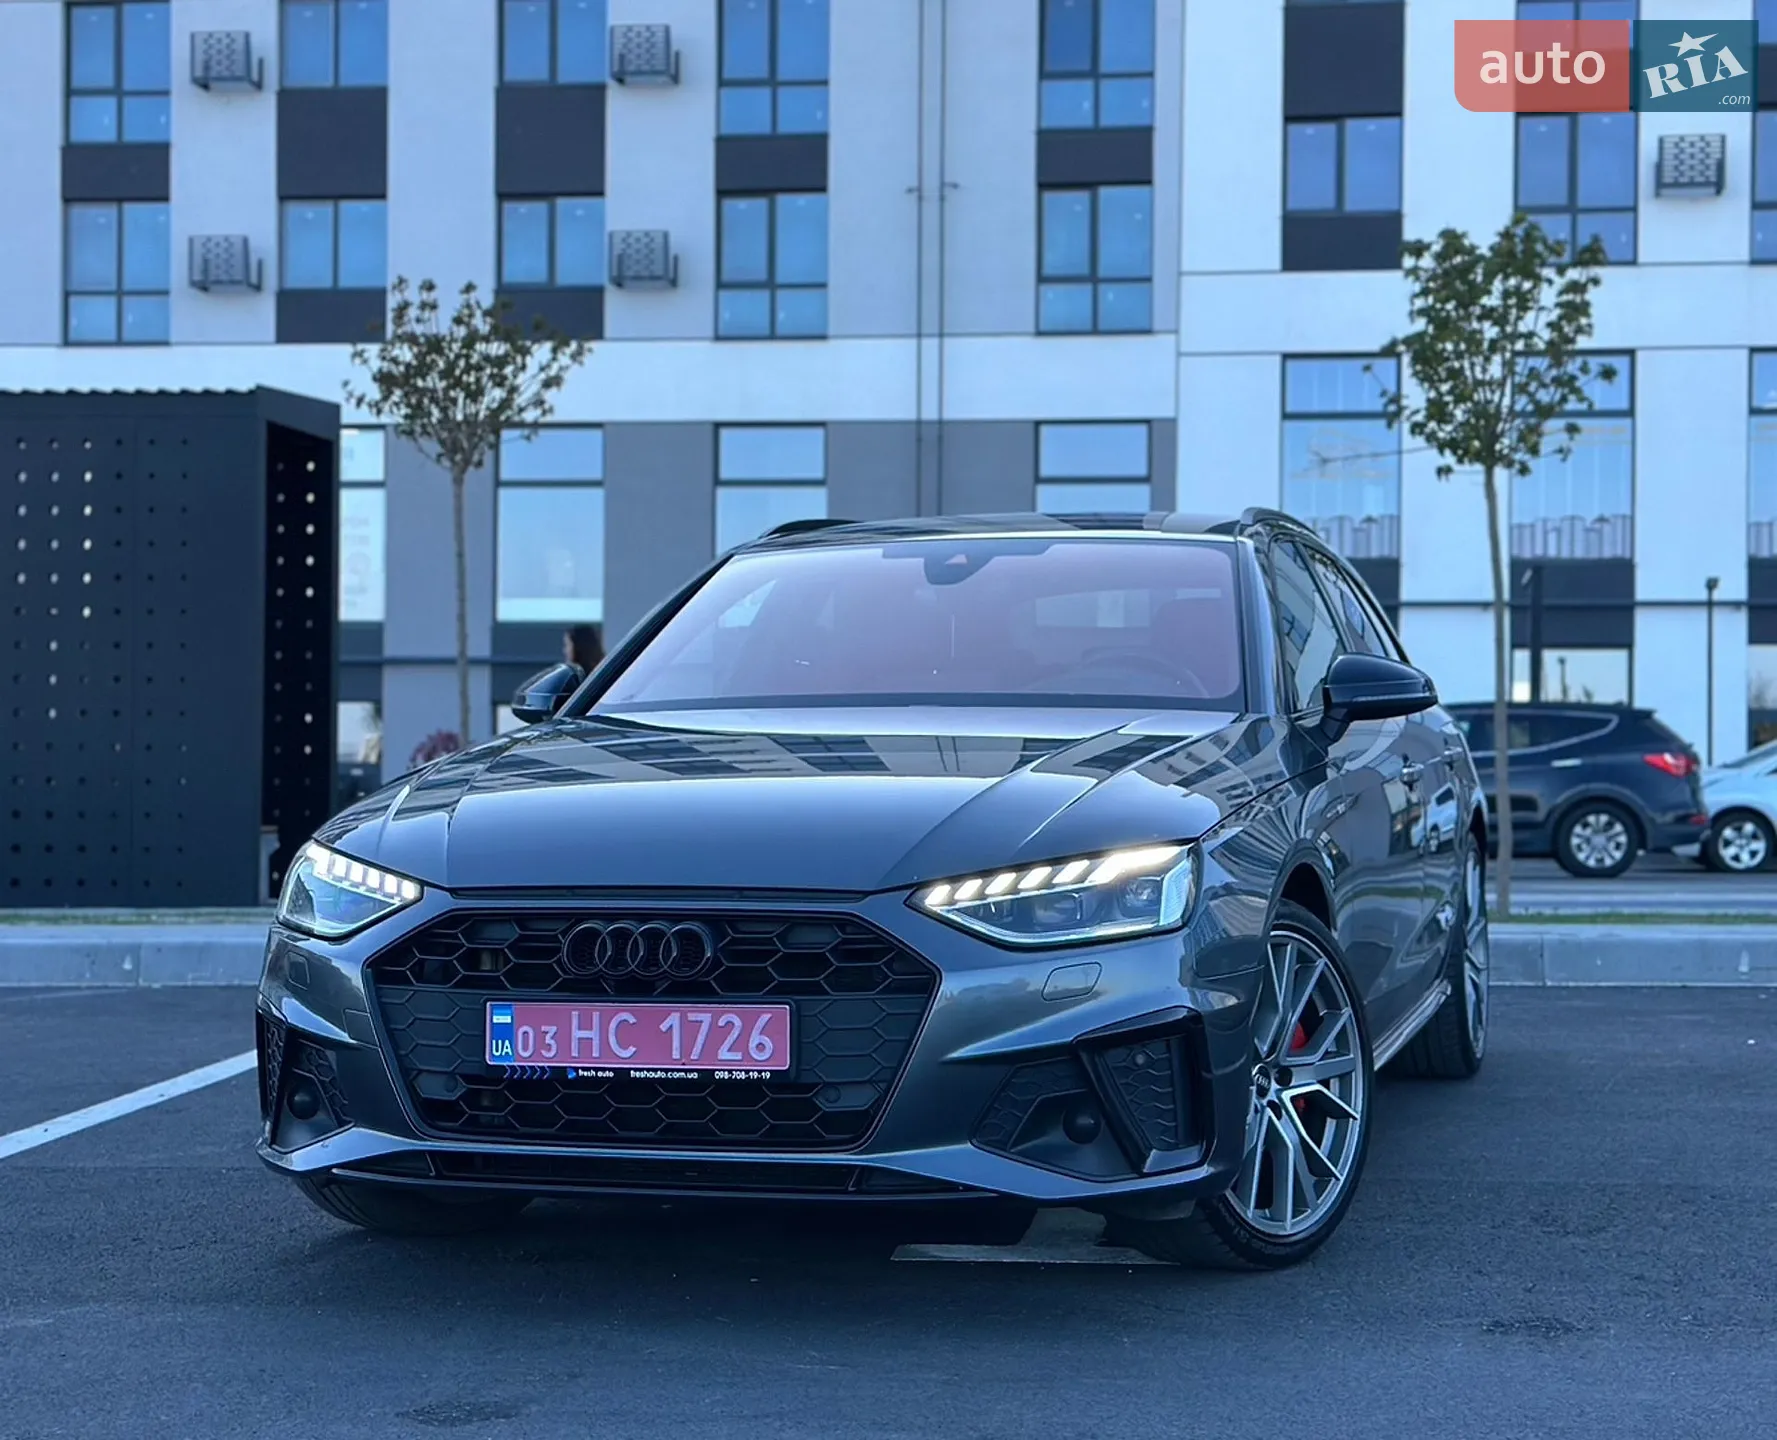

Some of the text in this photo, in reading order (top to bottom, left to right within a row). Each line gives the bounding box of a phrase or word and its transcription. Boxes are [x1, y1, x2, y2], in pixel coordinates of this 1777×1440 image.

[517, 1011, 773, 1061] 03 HC 1726
[492, 1039, 512, 1056] UA
[579, 1069, 596, 1077] fresh
[630, 1069, 698, 1079] freshauto.com.ua
